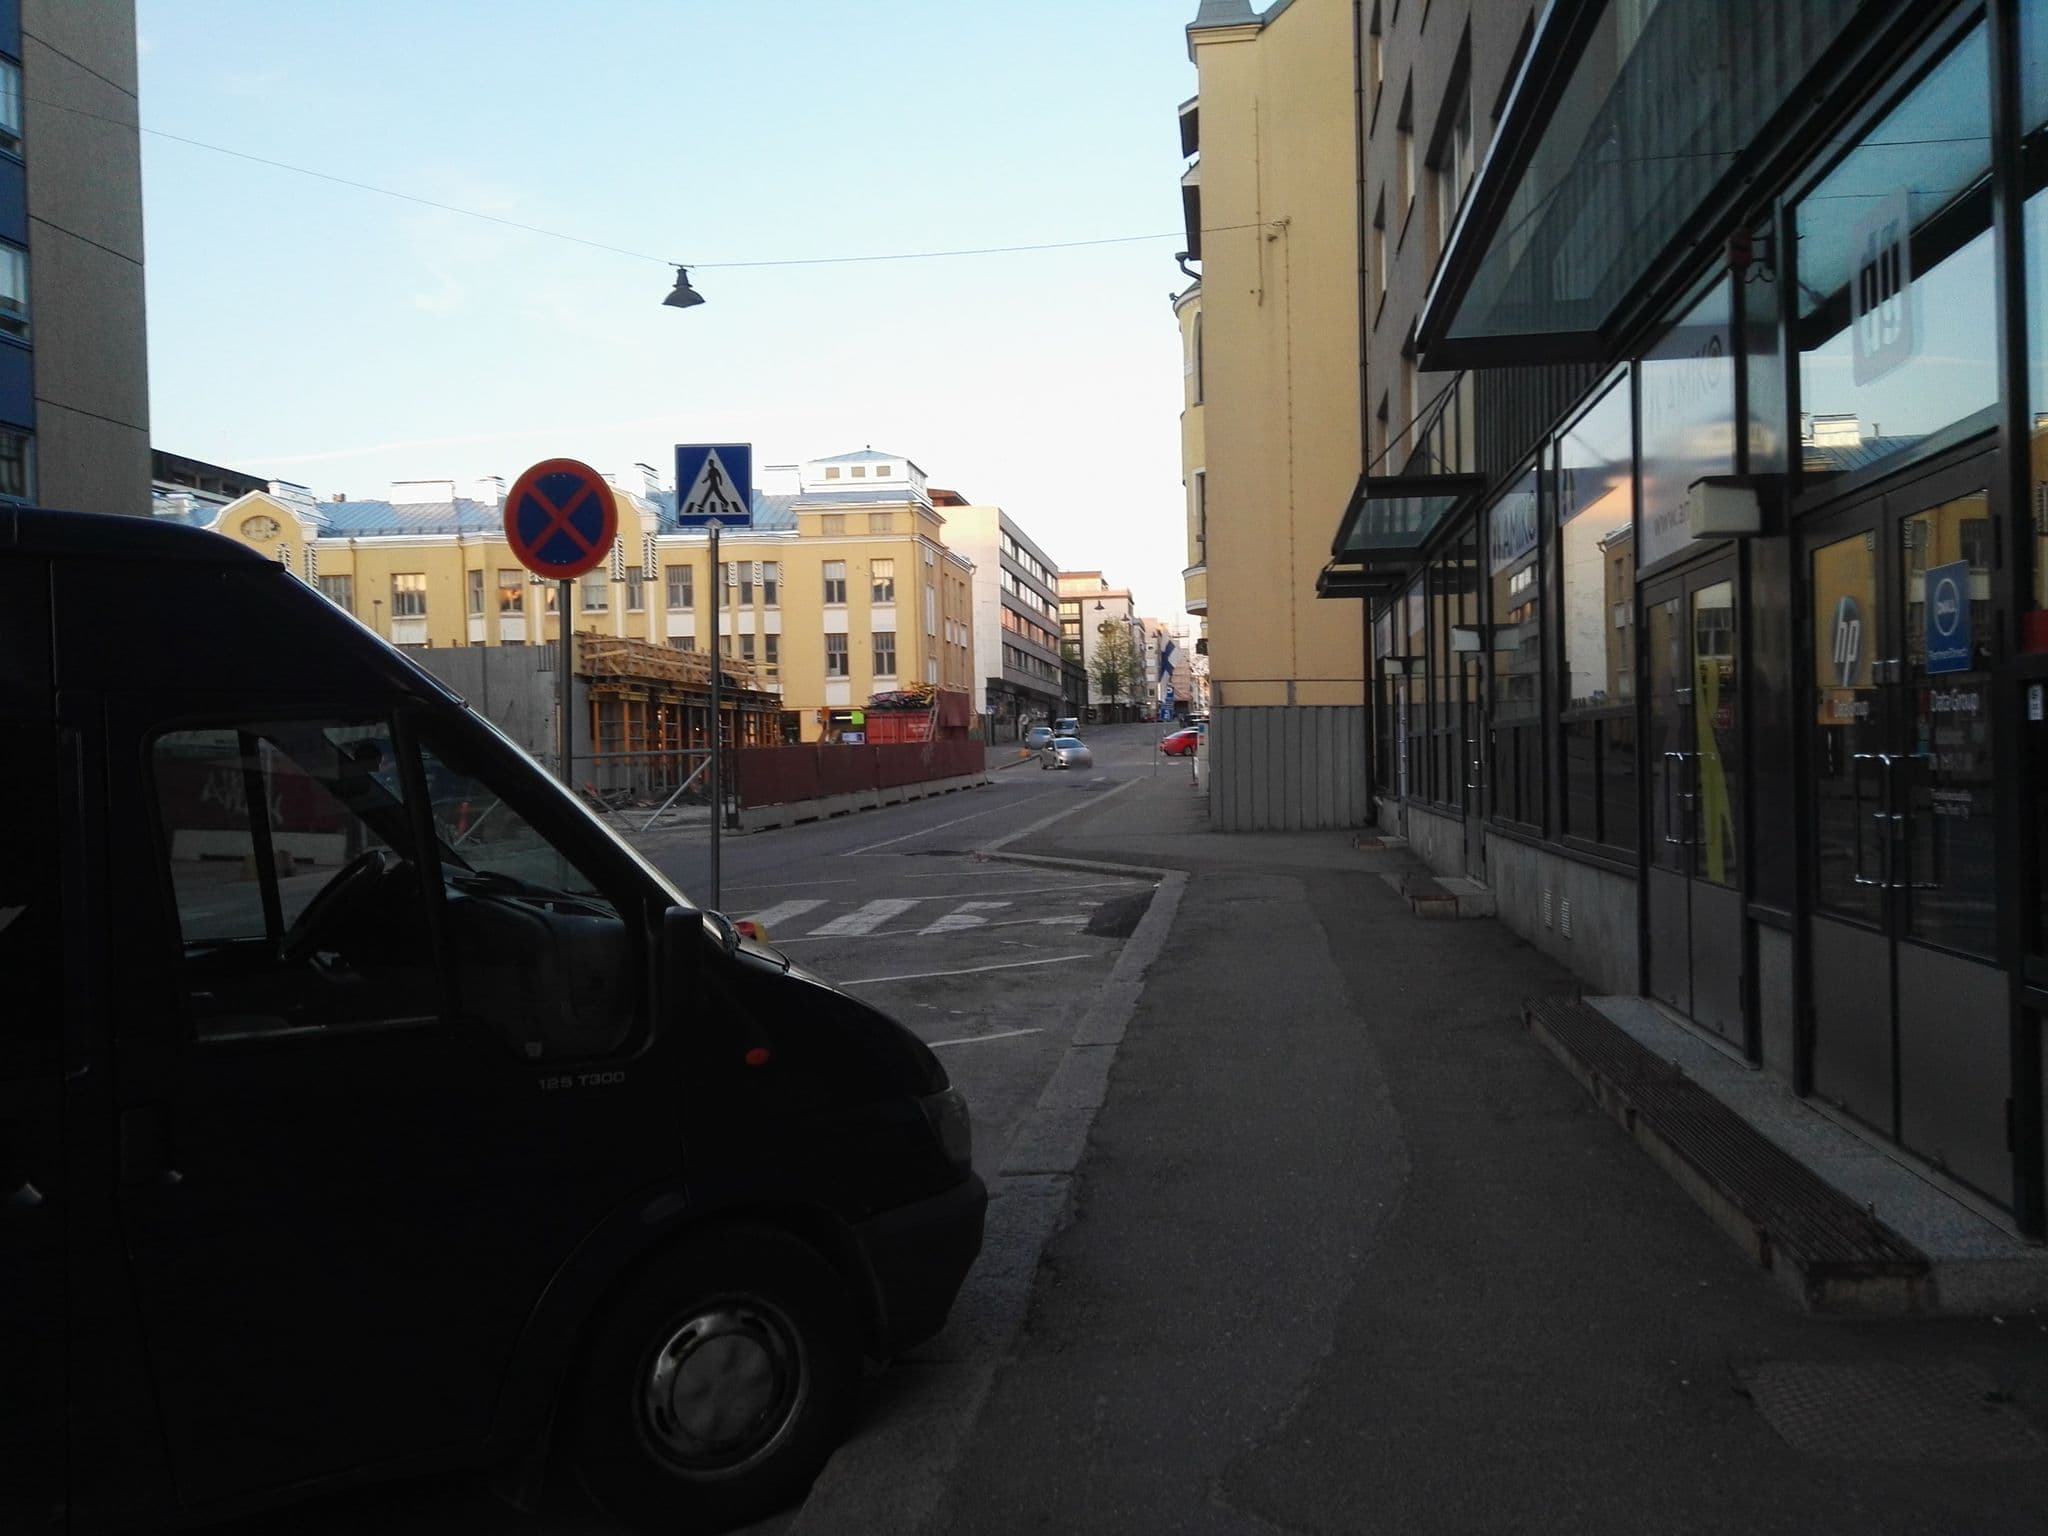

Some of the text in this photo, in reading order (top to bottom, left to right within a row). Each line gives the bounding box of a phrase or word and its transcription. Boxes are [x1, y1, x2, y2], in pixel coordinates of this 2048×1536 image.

[1834, 596, 1860, 687] hp
[537, 1071, 626, 1090] 125 T300
